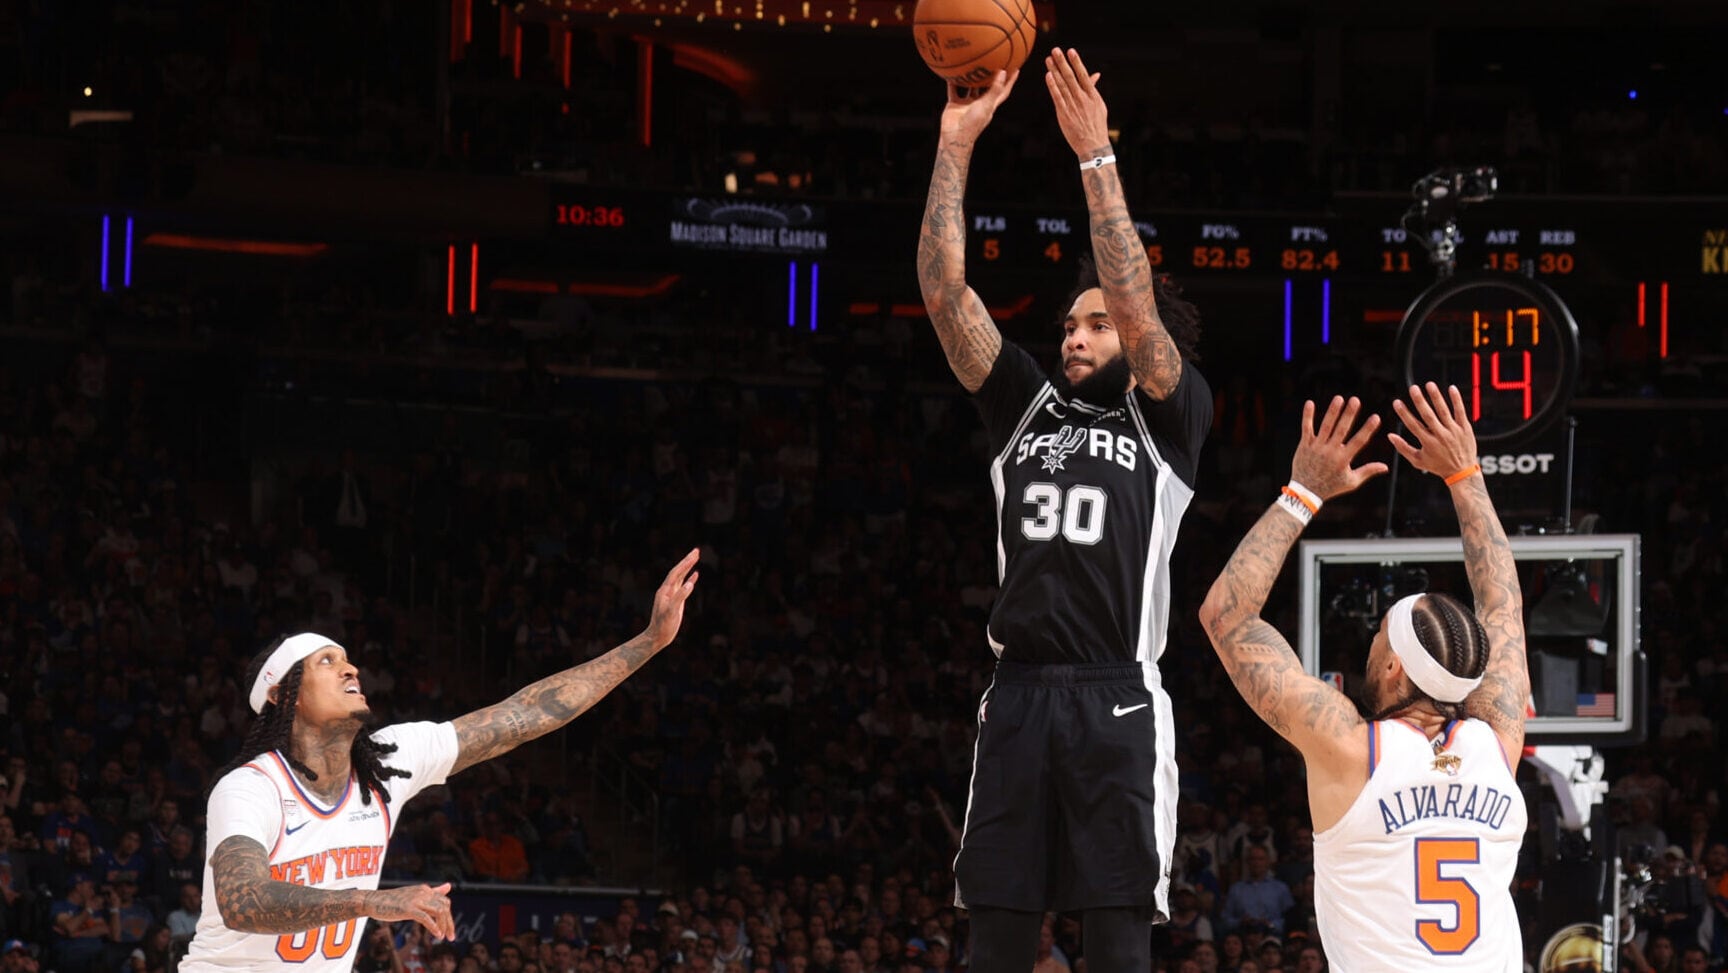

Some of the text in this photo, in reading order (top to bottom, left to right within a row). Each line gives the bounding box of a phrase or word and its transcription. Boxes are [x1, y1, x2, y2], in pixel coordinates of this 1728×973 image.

[557, 205, 624, 227] 10:36
[671, 221, 827, 249] MADISON SQUARE GARDEN
[975, 217, 1006, 231] FLS
[1037, 219, 1070, 234] TOL
[1202, 225, 1239, 240] FG%
[1291, 227, 1327, 243] FT%
[1486, 229, 1519, 244] AST
[1540, 230, 1576, 245] REB
[983, 240, 999, 261] 5
[1045, 242, 1062, 262] 4
[1193, 247, 1251, 269] 52.5
[1281, 250, 1340, 271] 82.4
[1381, 251, 1411, 273] 11
[1540, 252, 1575, 275] 30
[1472, 307, 1540, 348] 1:17
[1471, 350, 1532, 422] 14
[1021, 481, 1108, 546] 30
[1378, 783, 1512, 835] ALVARADO
[269, 845, 384, 886] NEW YORK
[1414, 837, 1480, 956] 5
